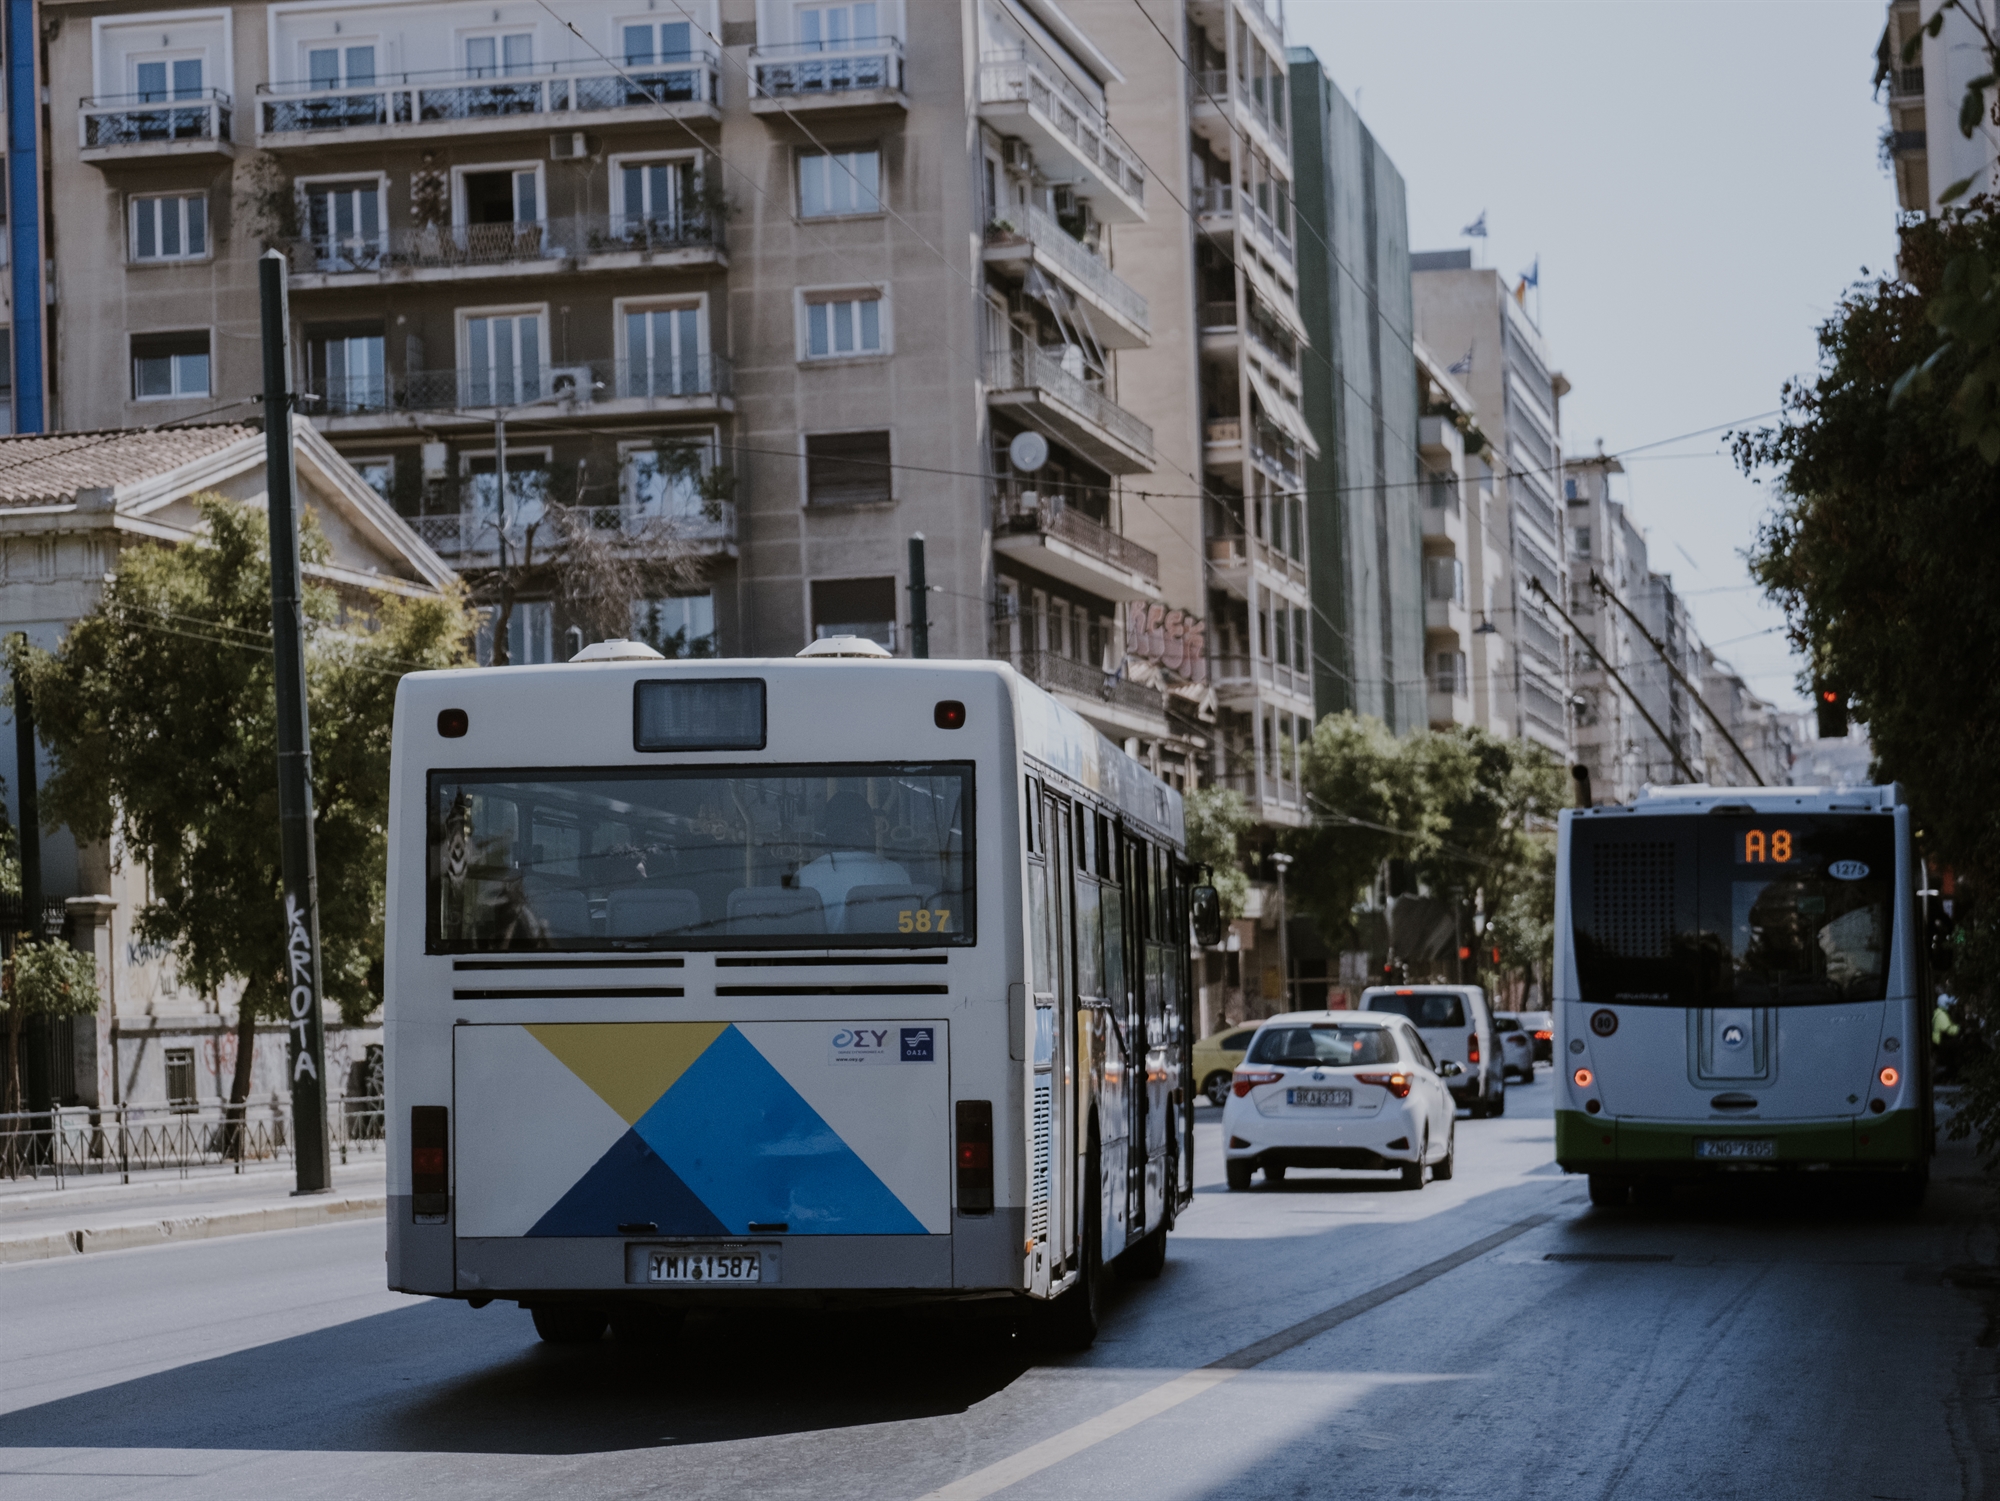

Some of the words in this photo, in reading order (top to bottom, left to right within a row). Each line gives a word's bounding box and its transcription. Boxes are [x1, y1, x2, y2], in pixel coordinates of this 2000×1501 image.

[1745, 829, 1792, 863] A8
[1836, 863, 1865, 876] 1275
[898, 909, 950, 933] 587
